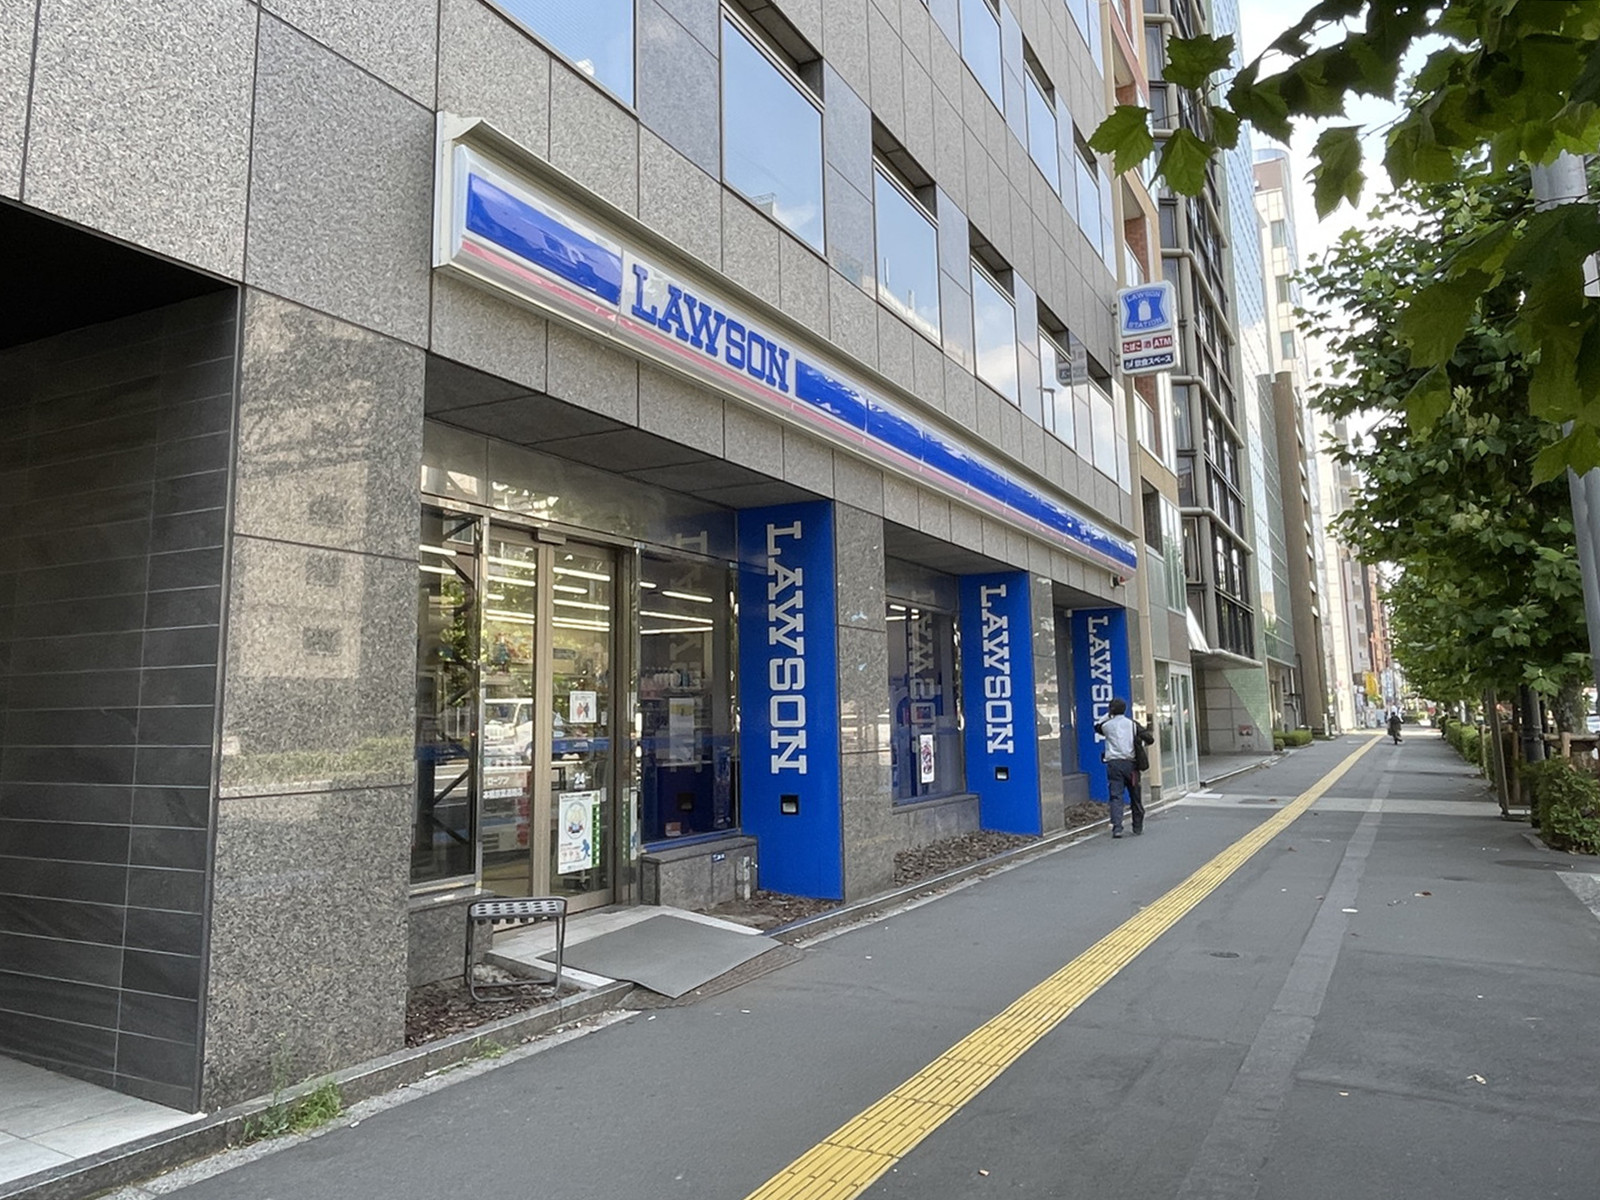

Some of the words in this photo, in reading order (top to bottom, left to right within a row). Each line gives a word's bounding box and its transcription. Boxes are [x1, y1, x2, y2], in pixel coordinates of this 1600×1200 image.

[631, 264, 790, 393] LAWSON
[1127, 290, 1161, 302] LAWSON
[1129, 317, 1163, 329] STATION
[1154, 337, 1171, 347] ATM
[766, 520, 807, 775] LAWSON
[980, 584, 1014, 754] LAWSON
